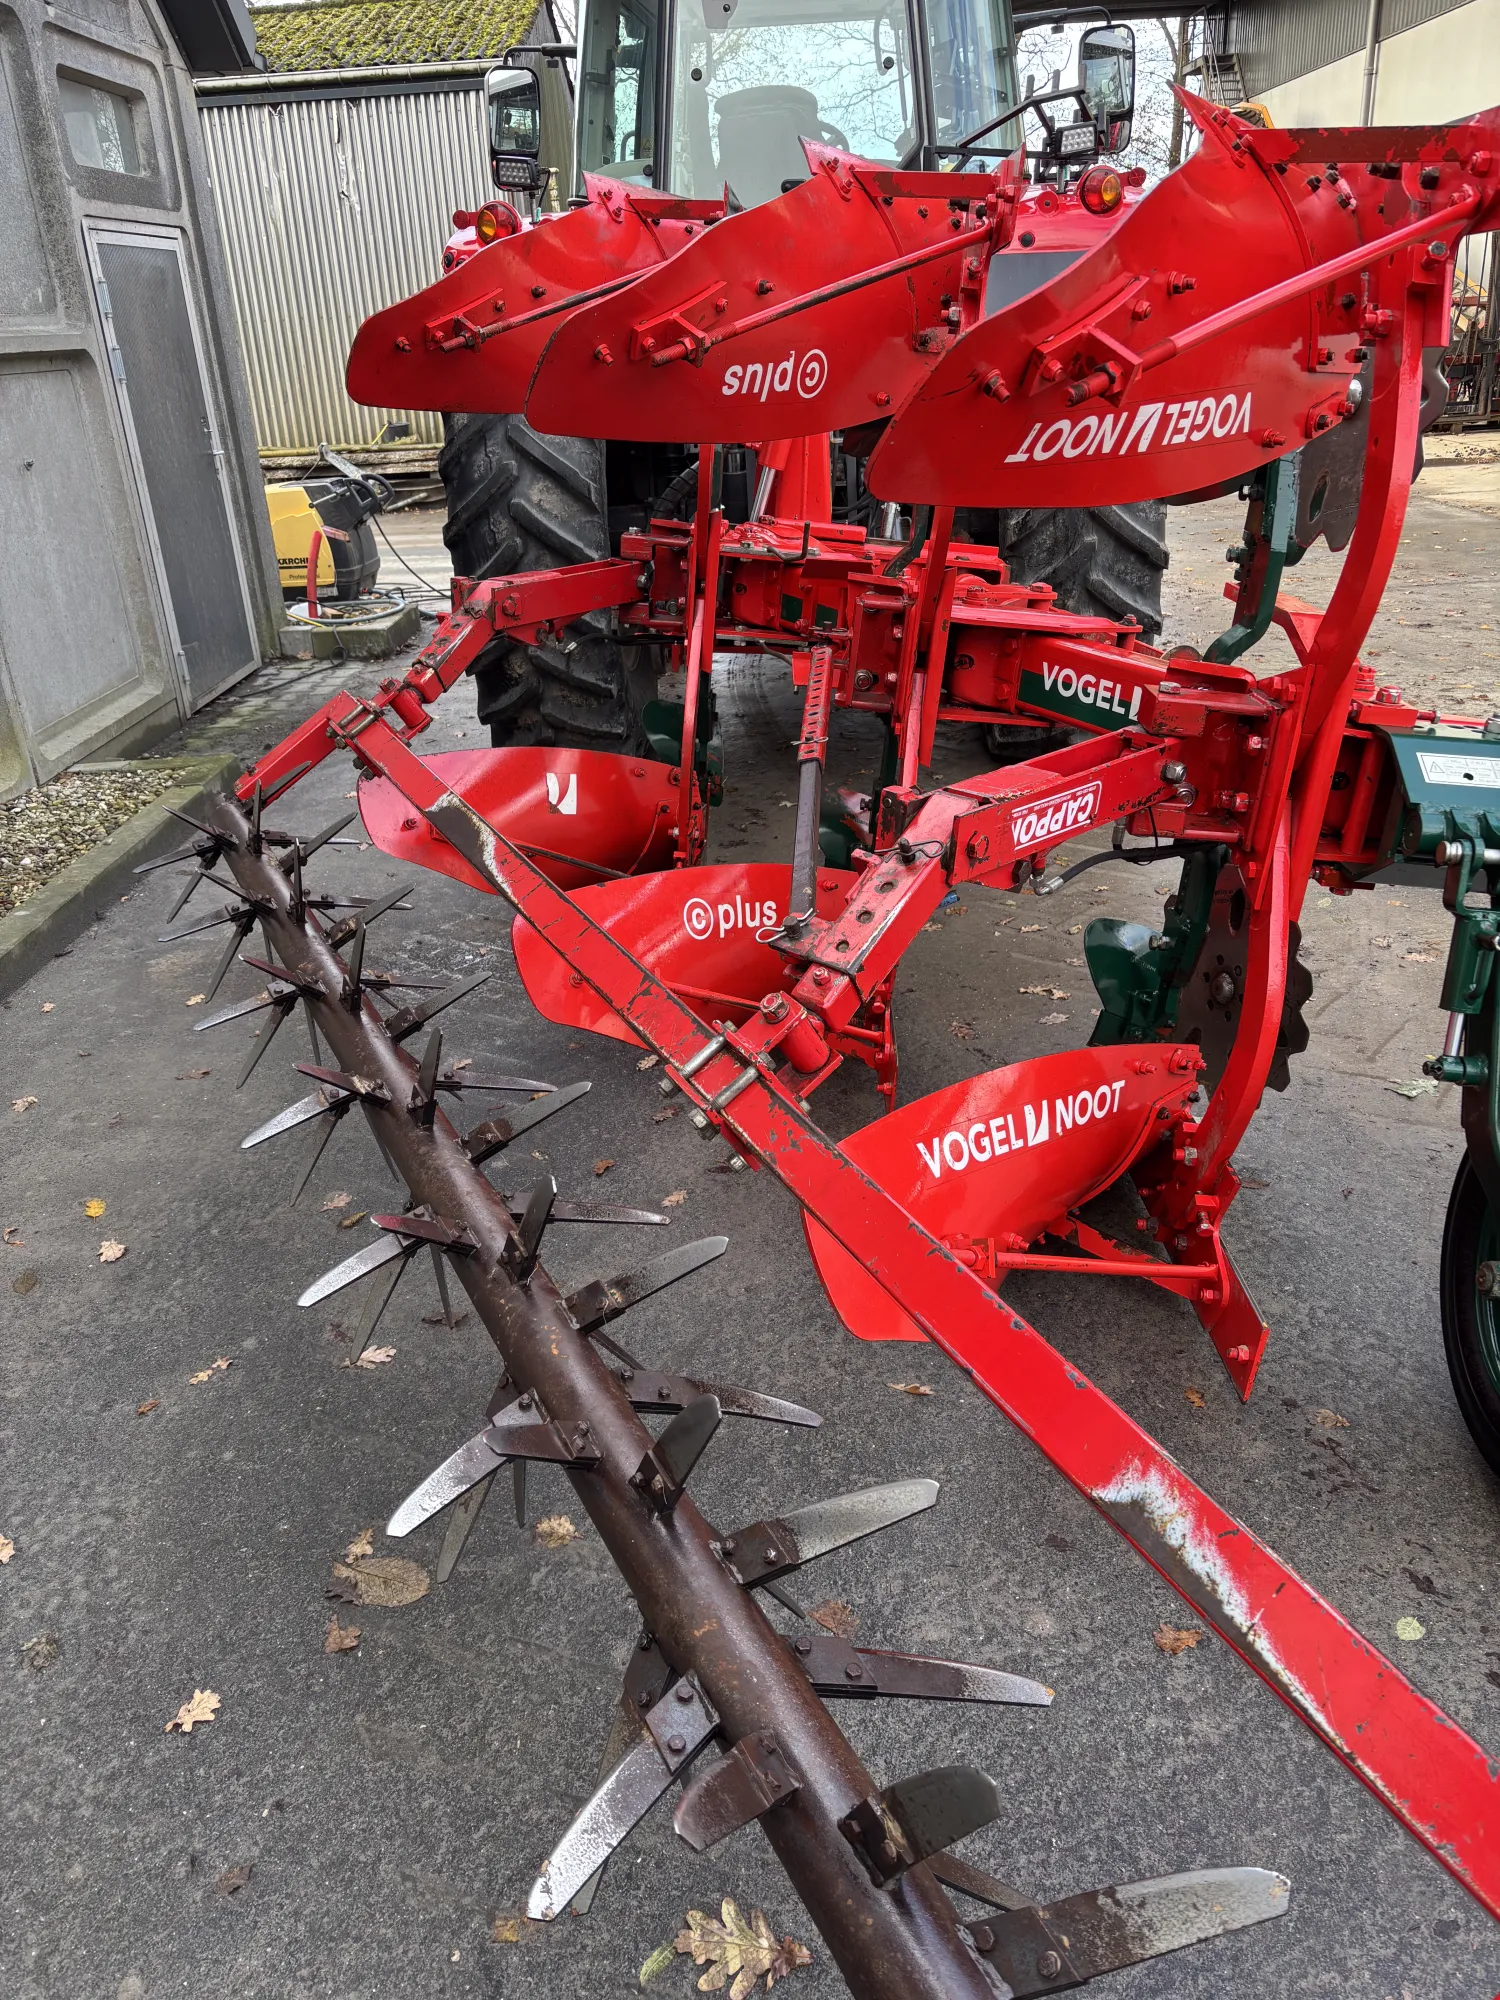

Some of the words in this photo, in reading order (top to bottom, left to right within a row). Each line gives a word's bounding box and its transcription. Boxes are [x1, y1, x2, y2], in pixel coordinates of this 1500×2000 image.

[1003, 412, 1129, 463] NOOT
[1162, 392, 1252, 446] VOGEL
[1042, 661, 1126, 715] VOGEL
[916, 1114, 1024, 1179] VOGEL
[1055, 1080, 1126, 1134] NOOT
